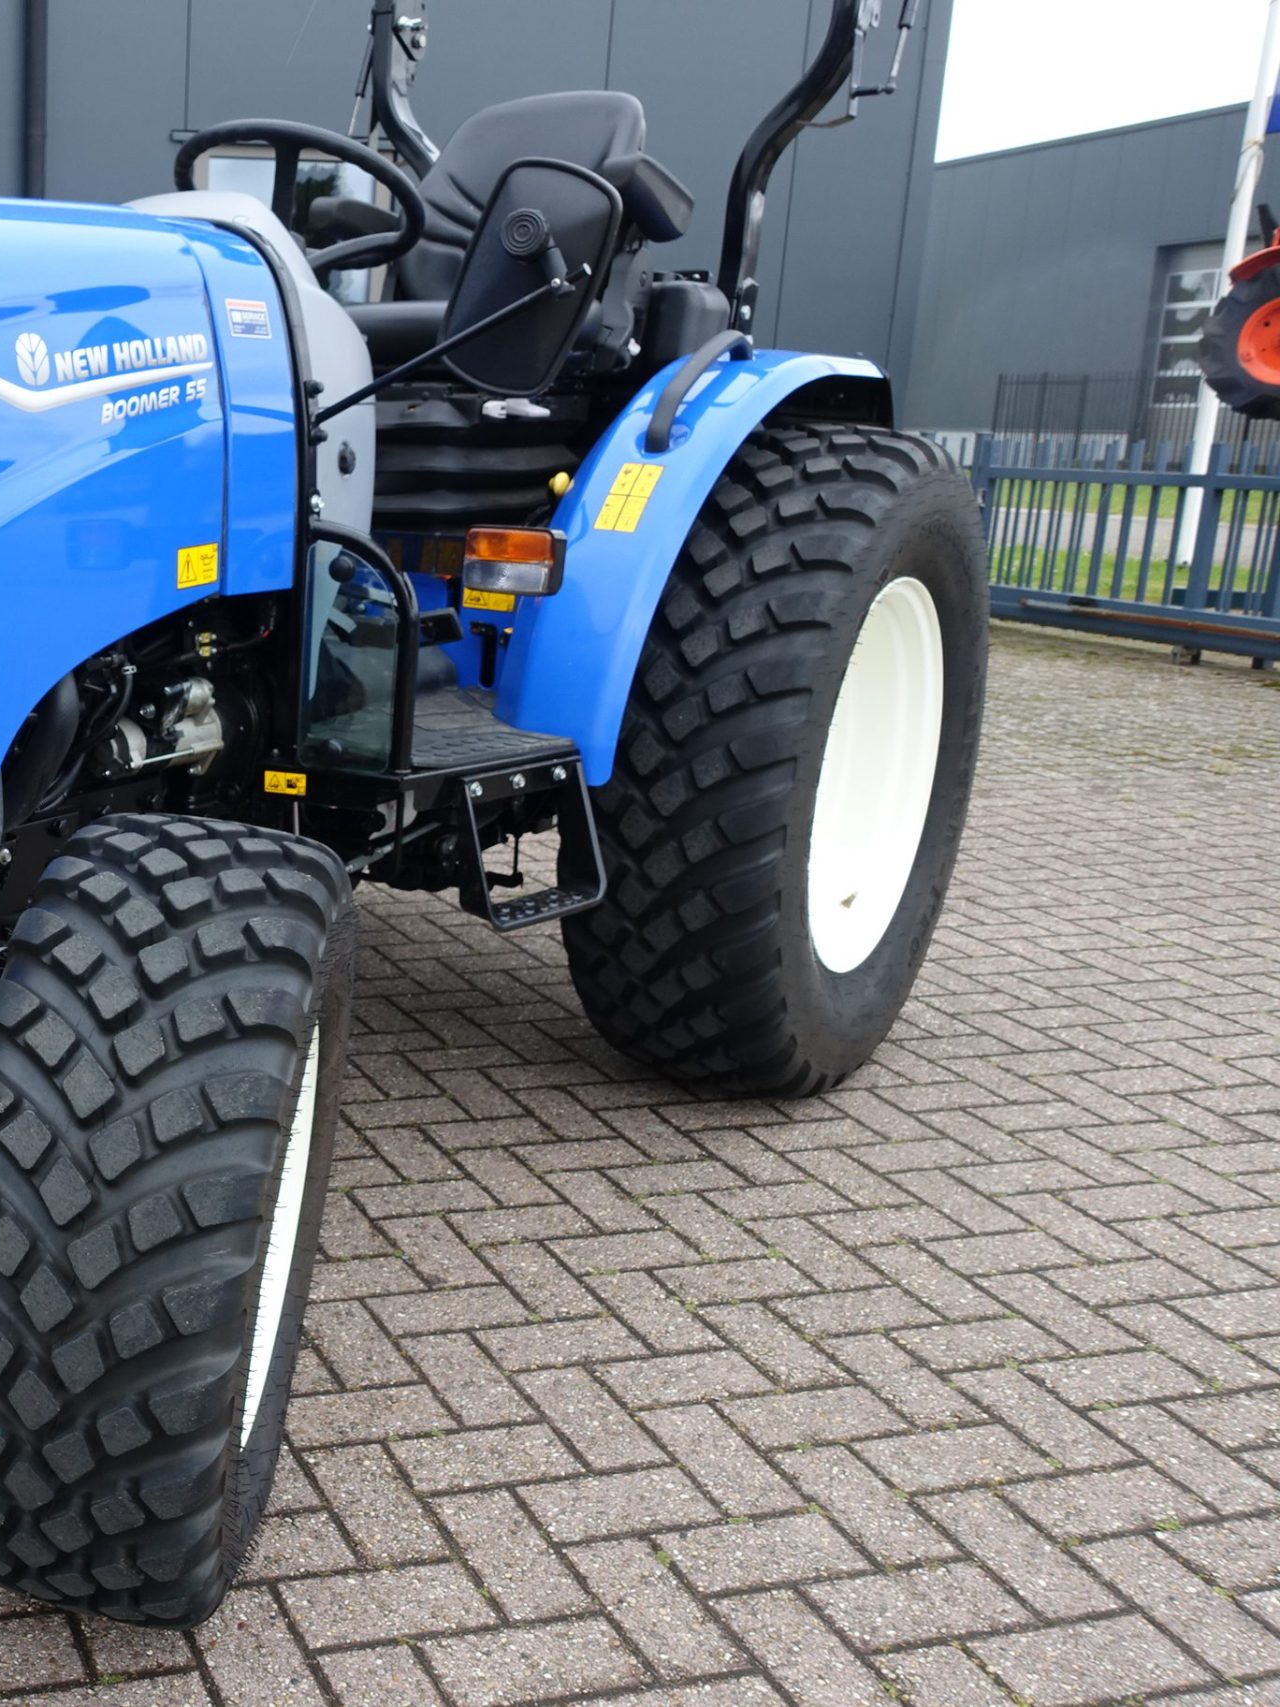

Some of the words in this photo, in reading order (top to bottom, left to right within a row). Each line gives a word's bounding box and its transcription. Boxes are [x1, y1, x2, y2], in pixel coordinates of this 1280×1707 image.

[54, 344, 109, 382] NEW
[112, 333, 208, 371] HOLLAND
[101, 385, 181, 424] BOOMER
[186, 378, 208, 400] 55
